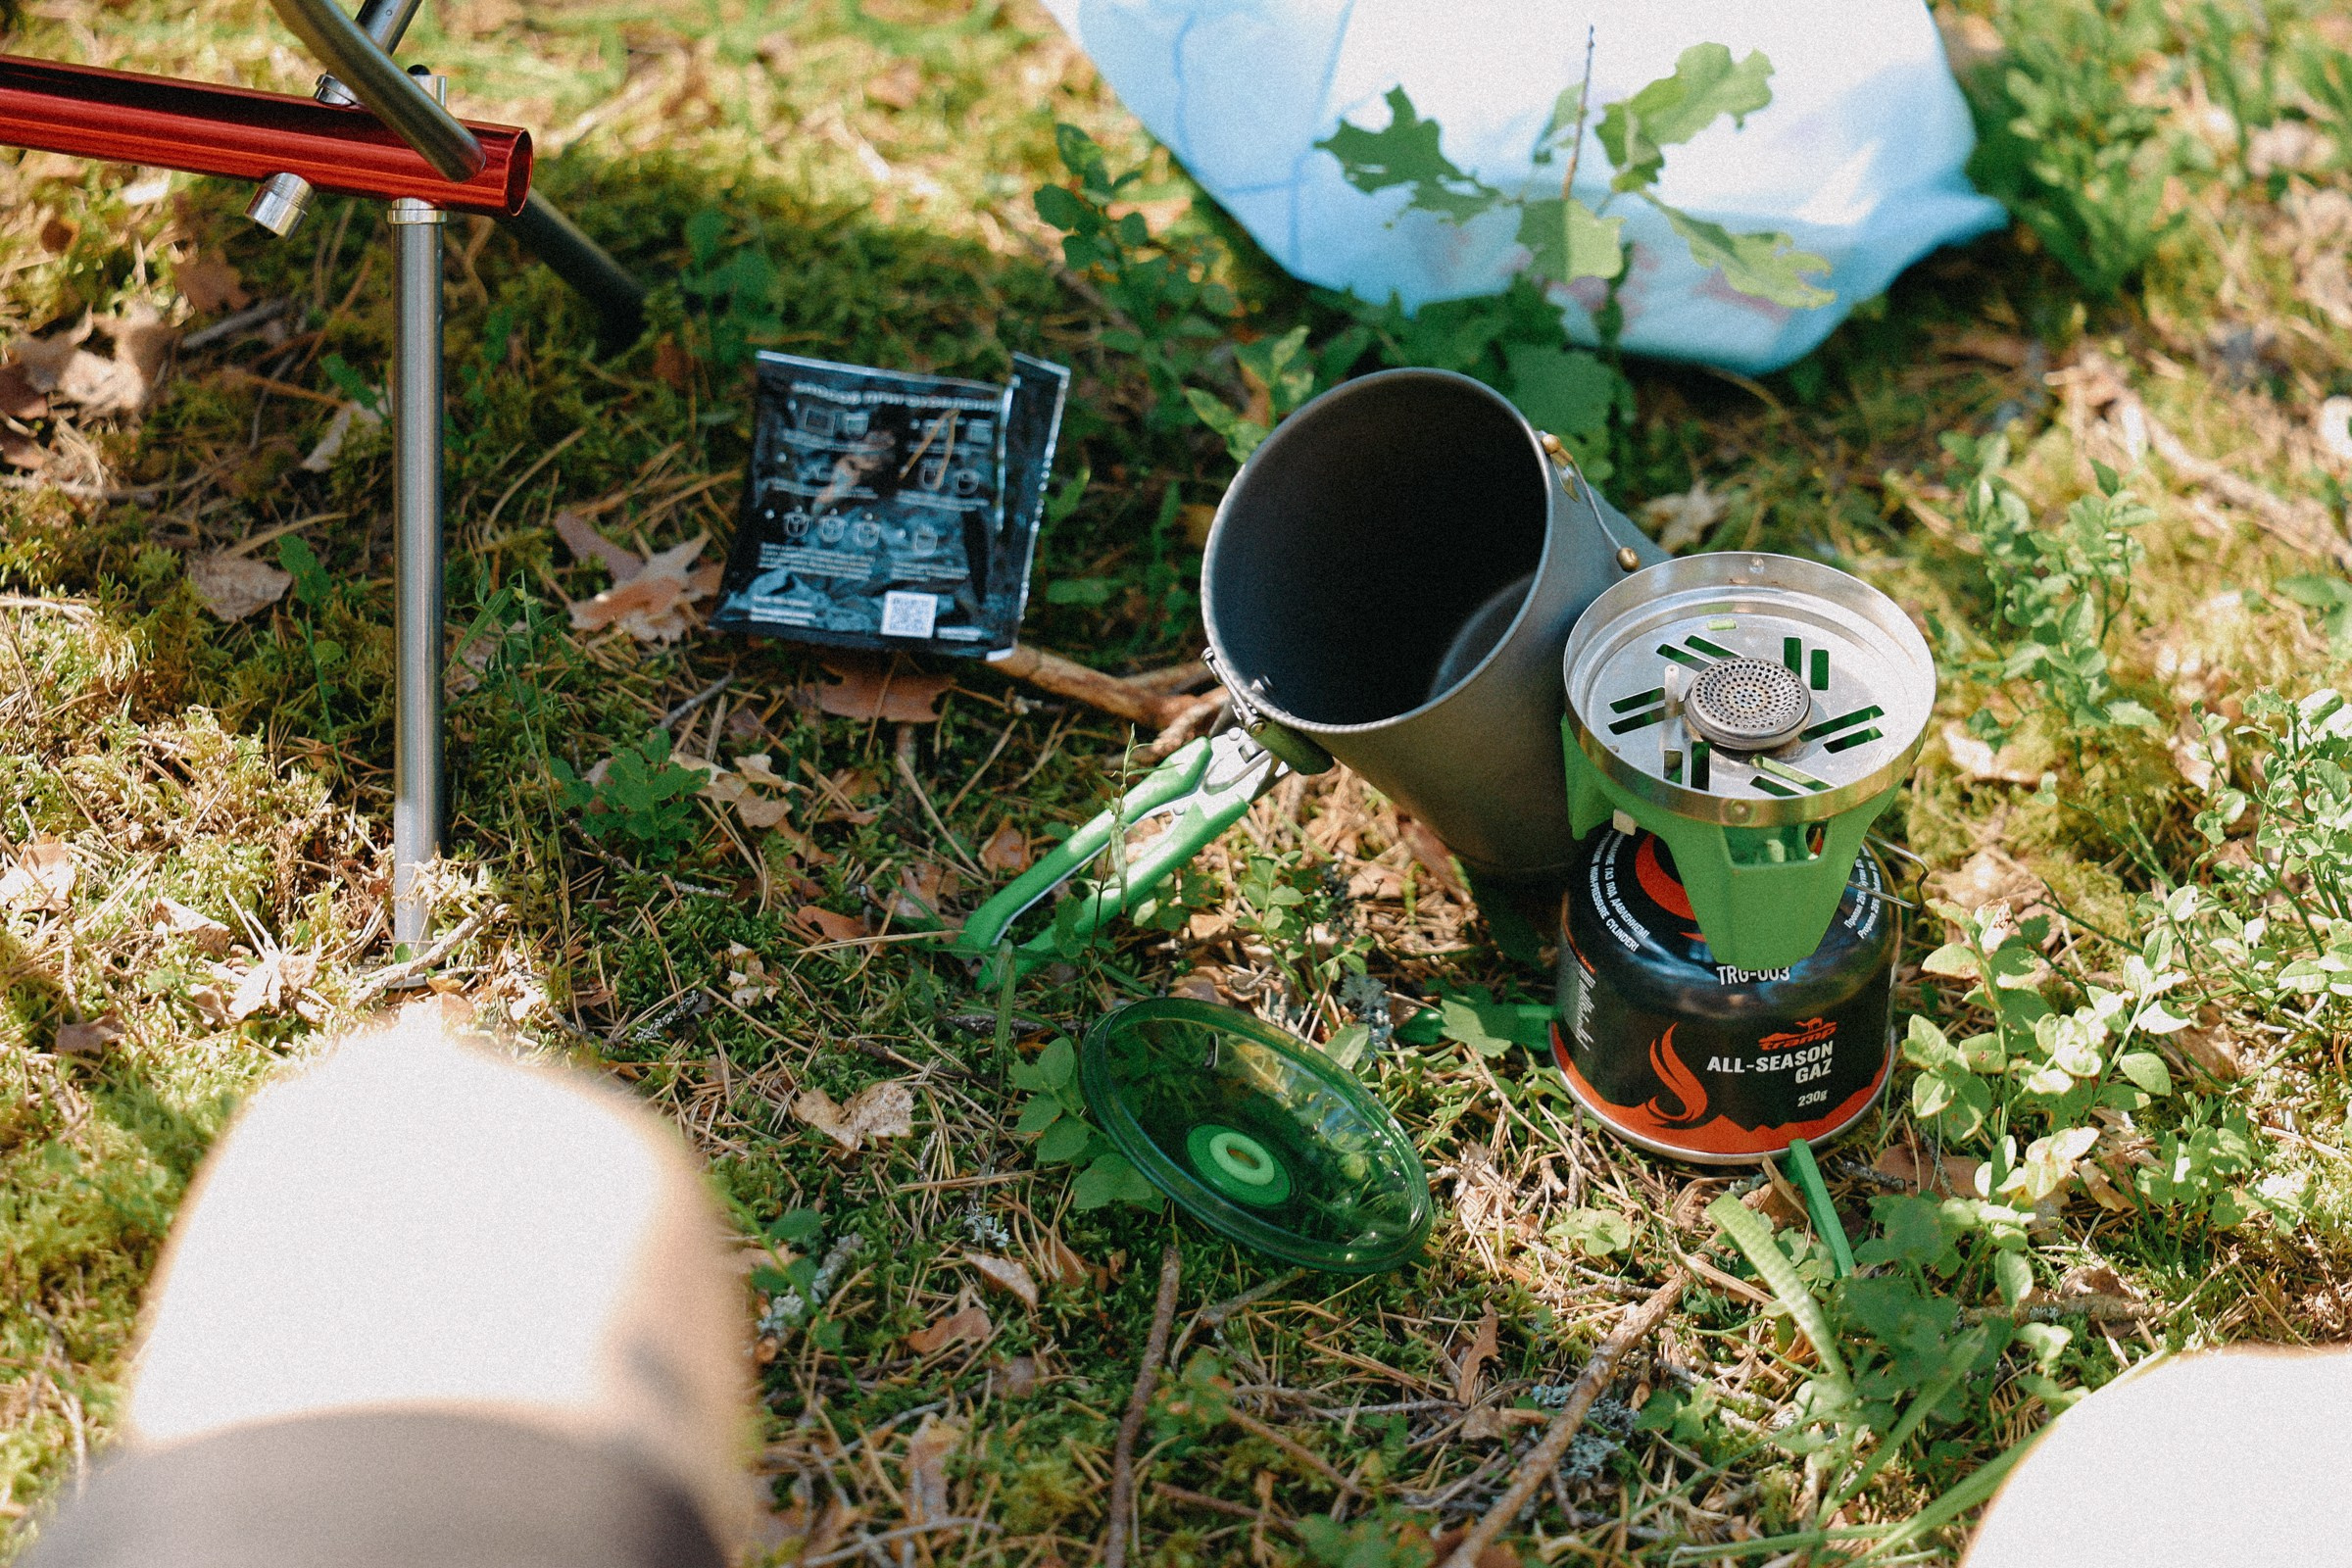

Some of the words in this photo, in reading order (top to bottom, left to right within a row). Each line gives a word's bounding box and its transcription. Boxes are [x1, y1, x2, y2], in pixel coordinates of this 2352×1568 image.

[1604, 866, 1614, 880] ГАЗ
[1605, 881, 1618, 899] ПОД
[1590, 864, 1610, 920] HIGH-PRESSURE
[1605, 917, 1640, 953] CYLINDER!
[1610, 898, 1650, 939] ДАВЛЕНИЕМ!
[1843, 904, 1863, 929] Пропан
[1857, 911, 1877, 940] Propane
[1716, 965, 1790, 986] TRG-003
[1759, 1026, 1838, 1052] tramp
[1706, 1040, 1834, 1074] ALL-SEASON
[1794, 1058, 1833, 1085] GAZ
[1797, 1089, 1829, 1107] 230g
